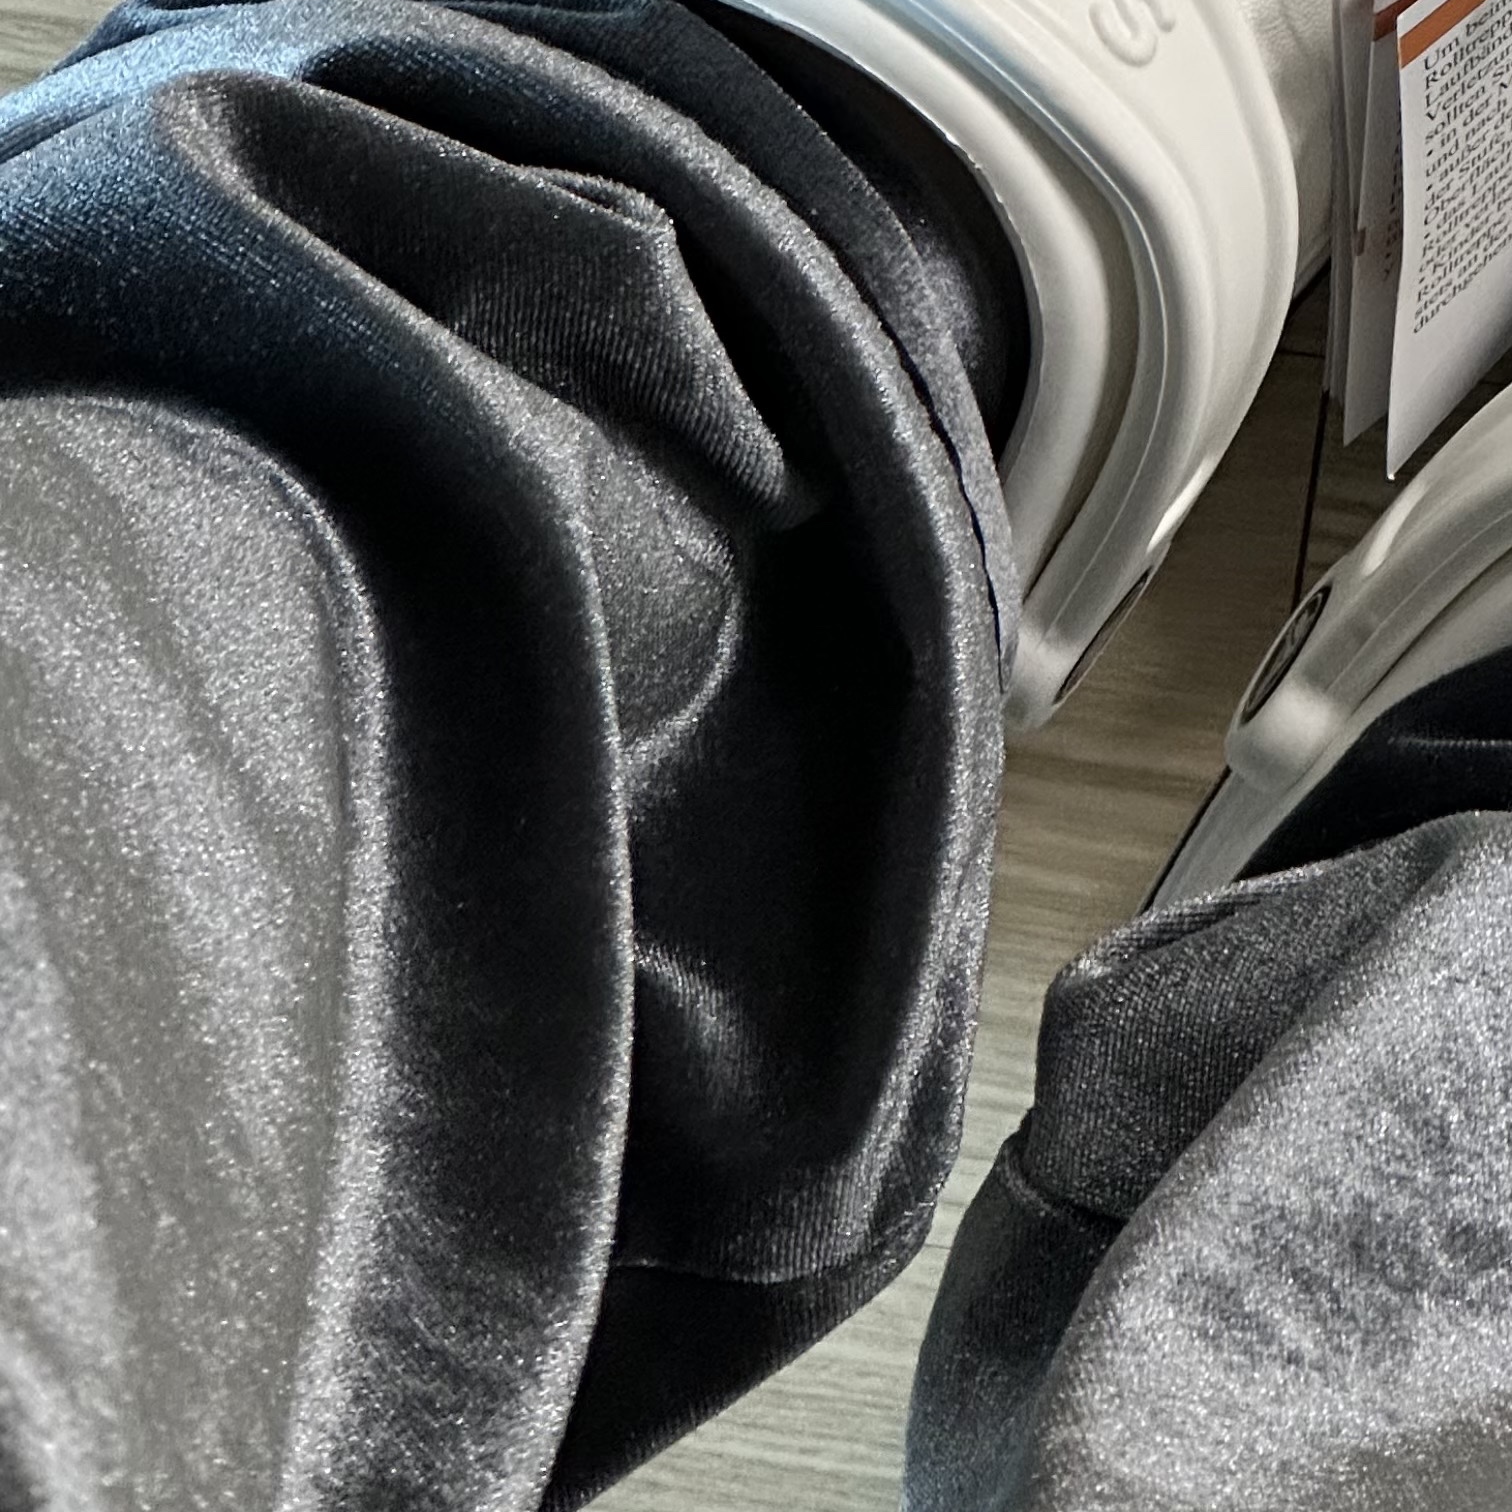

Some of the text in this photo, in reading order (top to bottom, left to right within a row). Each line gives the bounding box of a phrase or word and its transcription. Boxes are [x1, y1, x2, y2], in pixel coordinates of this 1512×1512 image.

[1423, 36, 1459, 69] Um
[1424, 82, 1486, 144] sollten
[1424, 137, 1459, 178] und
[1463, 96, 1507, 143] nach
[1440, 124, 1457, 148] in
[1461, 97, 1491, 128] der
[1424, 177, 1454, 212] der
[1457, 132, 1504, 180] Stufe
[1422, 165, 1512, 258] Rolltreppe
[1435, 197, 1466, 230] das
[1417, 210, 1508, 302] Rolltreppe
[1432, 213, 1493, 274] Kinder
